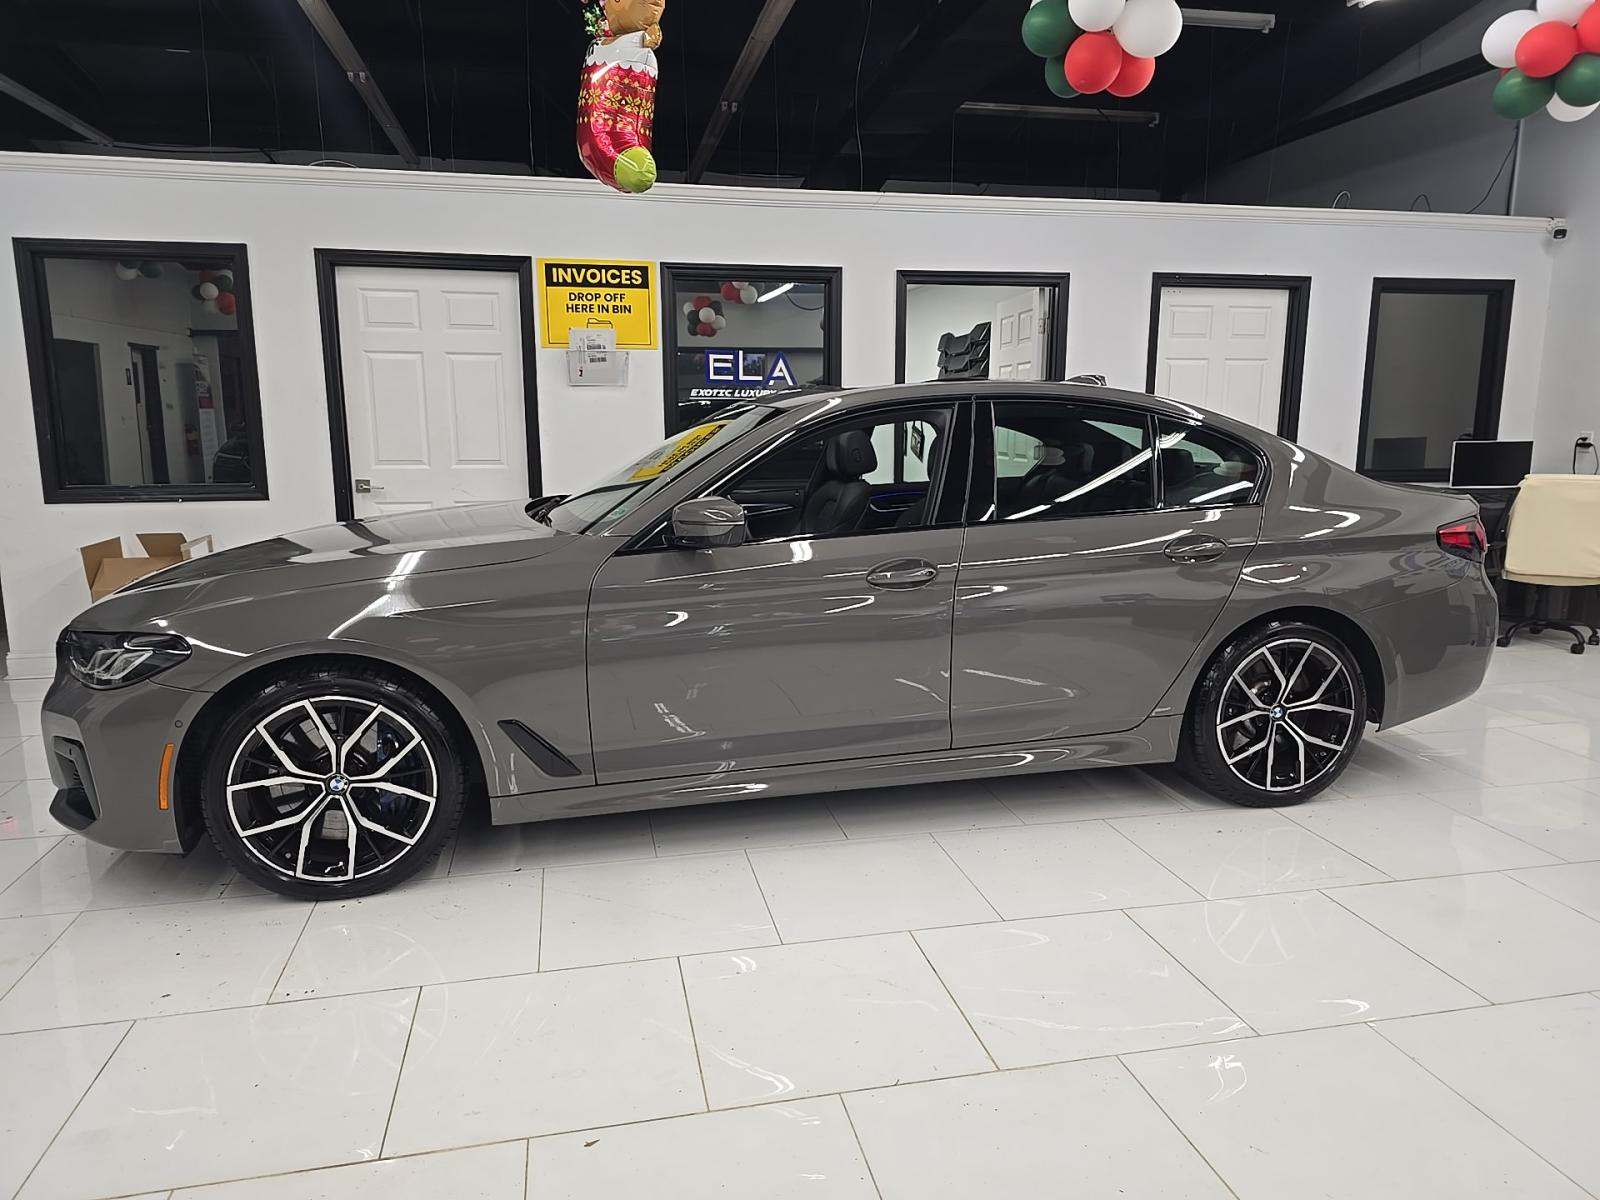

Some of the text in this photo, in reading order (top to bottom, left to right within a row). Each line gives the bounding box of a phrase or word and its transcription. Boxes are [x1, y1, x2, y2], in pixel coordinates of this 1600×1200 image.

[552, 267, 642, 285] INVOICES
[568, 291, 625, 303] DROP OFF
[565, 303, 632, 314] HERE IN BIN
[706, 349, 797, 387] ELA
[690, 388, 732, 397] EXOTIC
